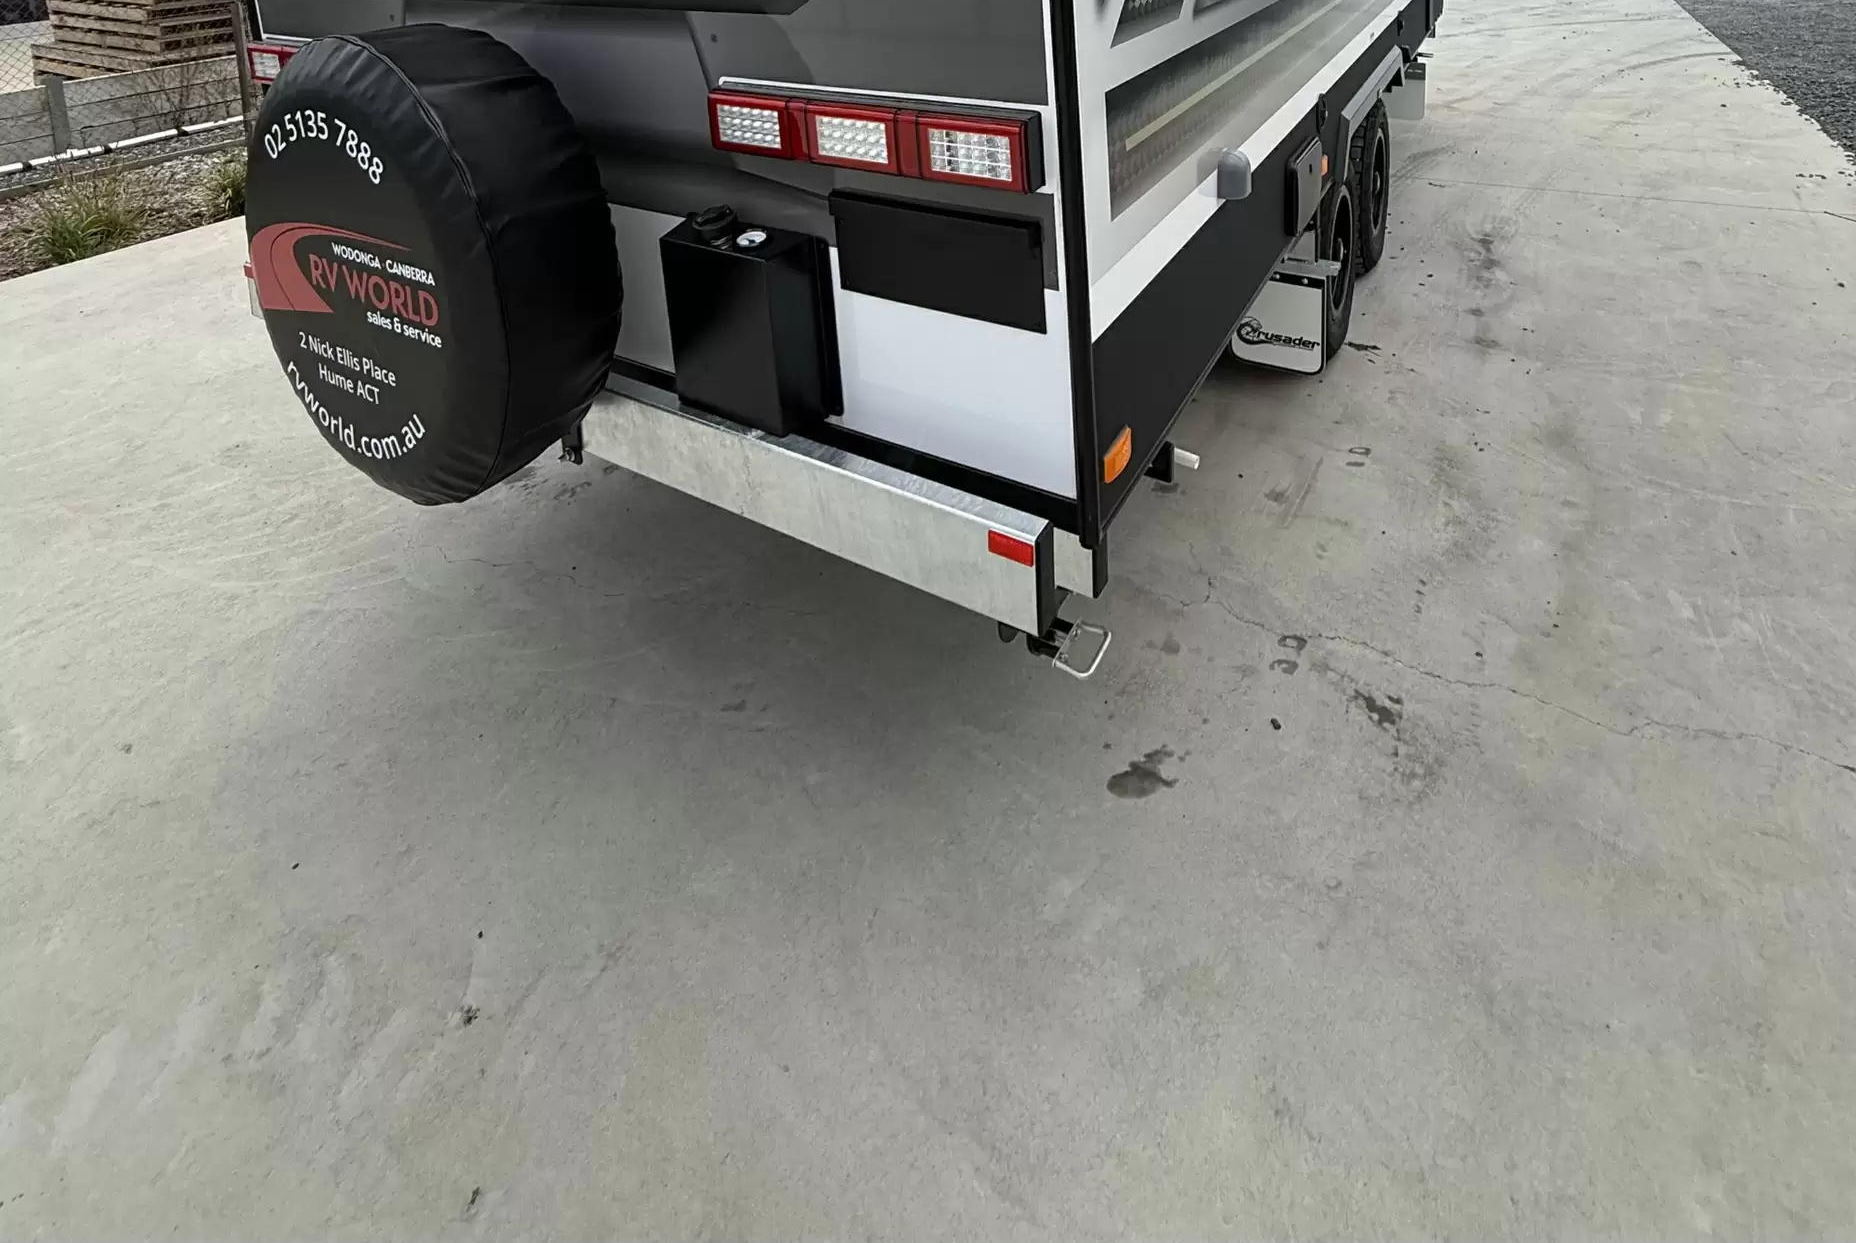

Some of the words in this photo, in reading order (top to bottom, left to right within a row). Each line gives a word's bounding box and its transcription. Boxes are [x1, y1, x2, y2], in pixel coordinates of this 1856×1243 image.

[264, 123, 287, 160] 02
[283, 109, 329, 141] 5135
[333, 117, 384, 185] 7888
[331, 241, 382, 270] WODONGA
[385, 258, 436, 287] CANBERRA
[308, 253, 338, 293] RV
[341, 264, 439, 327] WORLD
[366, 310, 393, 332] sales
[393, 317, 402, 334] &
[403, 323, 443, 349] service
[1236, 322, 1321, 349] Crusader
[299, 331, 308, 349] 2
[308, 334, 335, 362] Nick
[335, 346, 361, 372] Ellis
[362, 356, 397, 387] Place
[318, 362, 354, 394] Hume
[356, 379, 380, 405] ACT
[287, 360, 427, 460] rvworld.com.au
